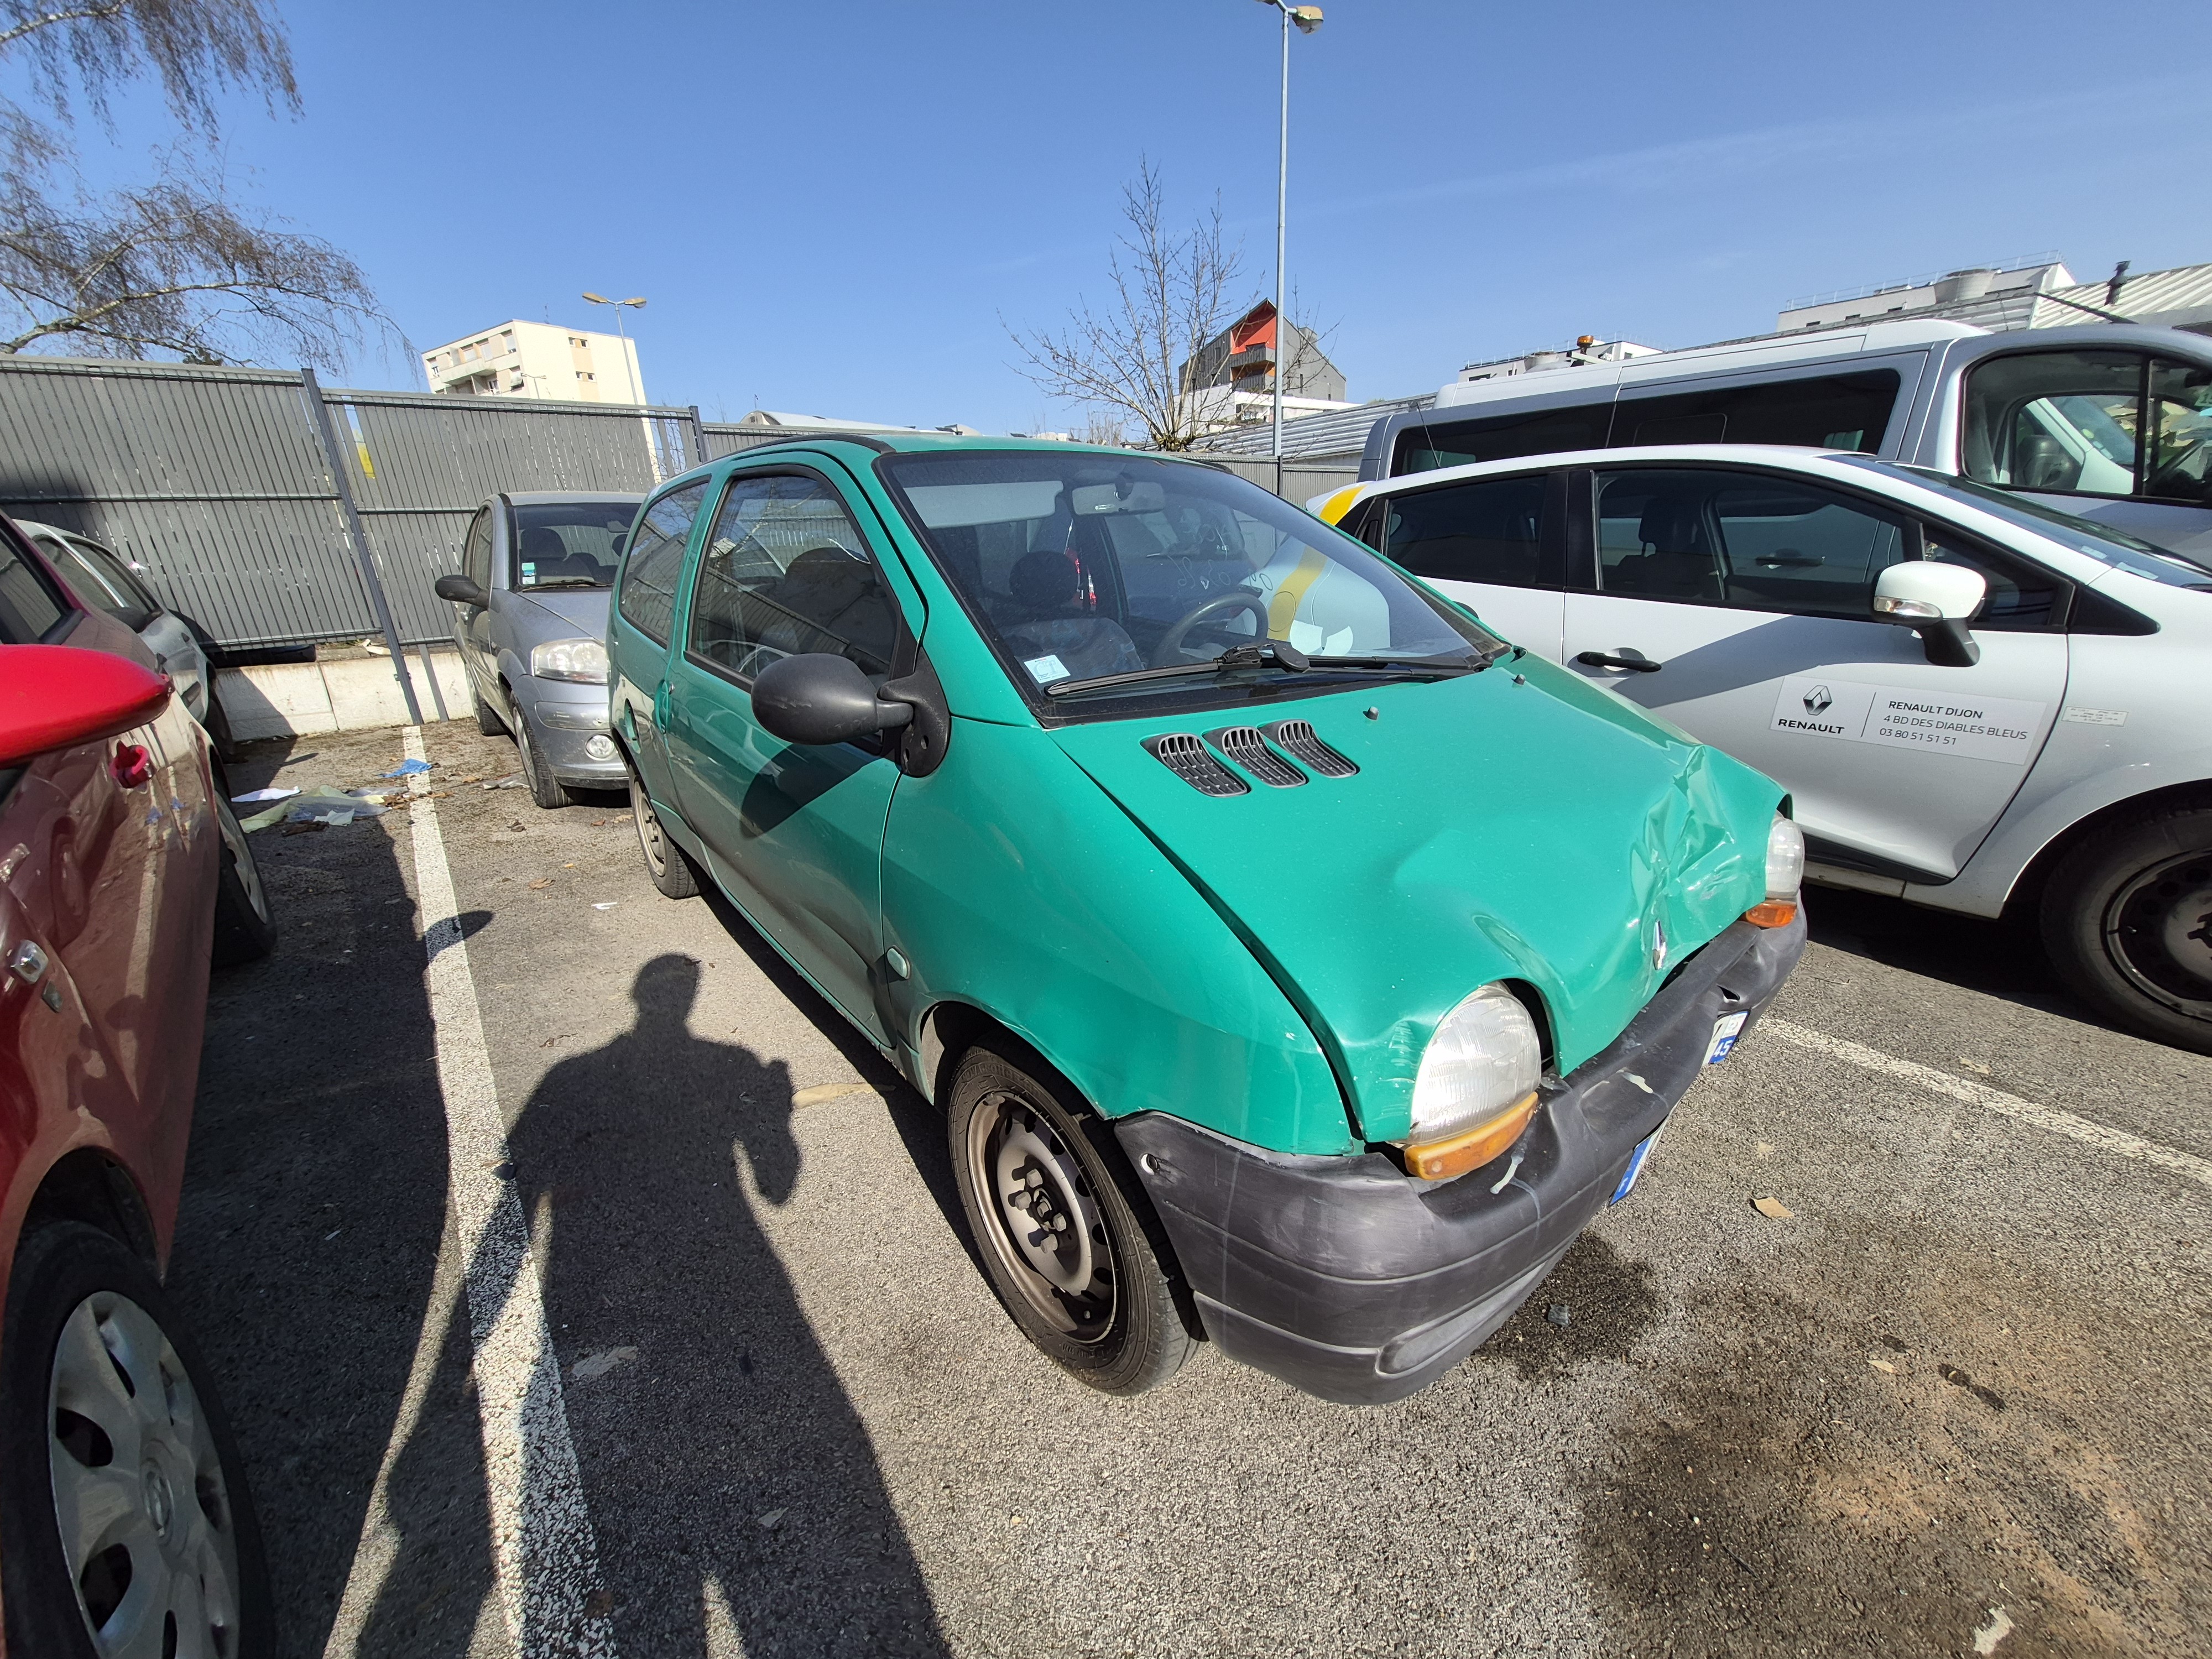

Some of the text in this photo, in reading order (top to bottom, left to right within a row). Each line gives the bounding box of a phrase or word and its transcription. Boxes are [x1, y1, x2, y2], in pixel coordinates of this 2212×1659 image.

[1888, 701, 1983, 719] RENAULT DIJON
[1778, 718, 1845, 734] RENAULT
[1892, 716, 1909, 724] BD
[1911, 718, 1934, 728] DES
[1936, 721, 1985, 734] DIABLES
[1986, 727, 2028, 740] BLEUS
[1880, 728, 1957, 745] 03 80 51 51 51
[1714, 1040, 1733, 1057] 45
